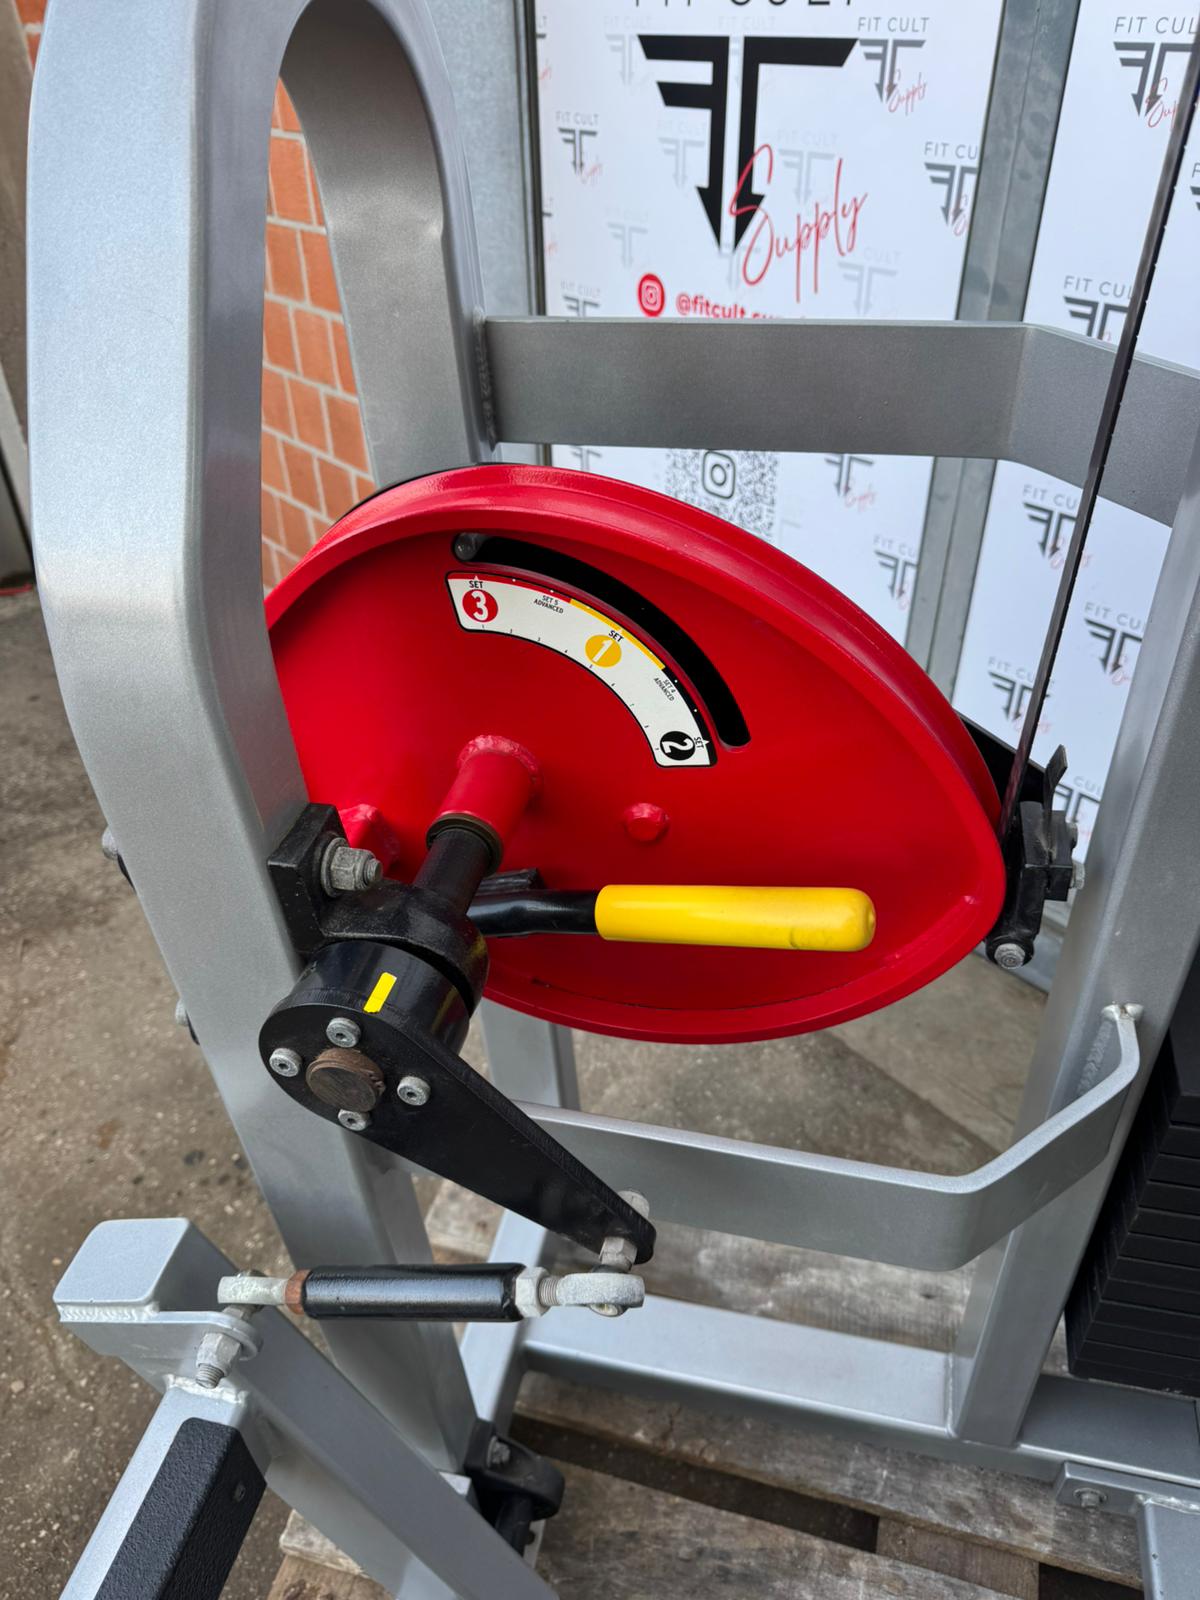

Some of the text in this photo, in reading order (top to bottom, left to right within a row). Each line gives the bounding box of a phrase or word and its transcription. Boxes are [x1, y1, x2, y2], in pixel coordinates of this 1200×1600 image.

[858, 16, 930, 32] FIT CULT
[1114, 16, 1148, 34] FIT
[555, 111, 600, 126] FIT CULT
[924, 141, 950, 158] FIT
[729, 143, 868, 303] Supply
[1063, 275, 1093, 293] FIT
[1023, 484, 1048, 501] FIT
[469, 580, 484, 589] SET
[470, 590, 489, 621] 3
[533, 598, 564, 614] ADVANCED
[542, 594, 555, 605] SET
[1084, 602, 1112, 619] FIT
[608, 629, 623, 643] SET
[592, 639, 613, 663] 1
[988, 656, 1011, 672] FIT
[653, 677, 675, 702] ADVANCED
[661, 738, 694, 754] 2
[693, 736, 705, 750] SET
